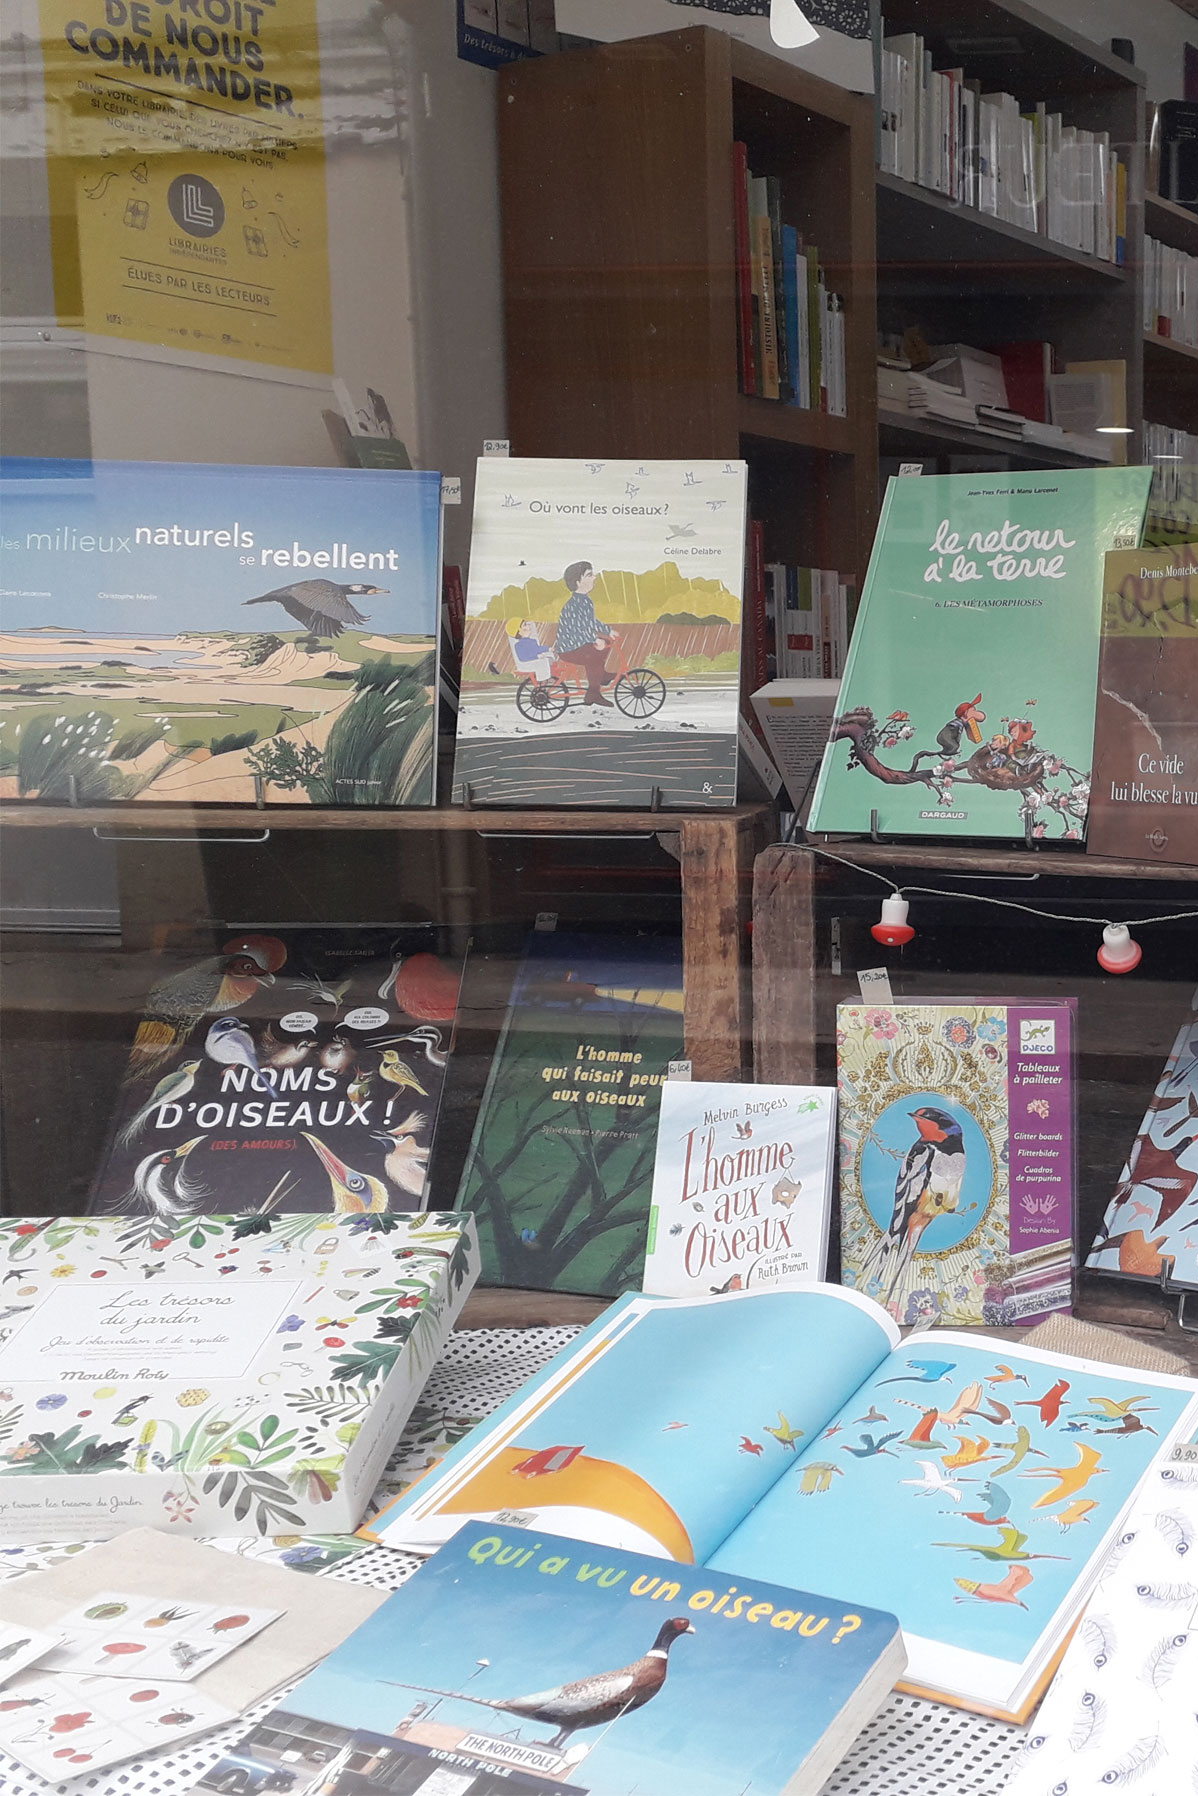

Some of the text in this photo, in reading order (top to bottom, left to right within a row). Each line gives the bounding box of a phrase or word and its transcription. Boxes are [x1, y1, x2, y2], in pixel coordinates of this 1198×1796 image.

[106, 0, 264, 72] DE NOUS
[64, 20, 304, 119] COMMANDER.
[168, 237, 227, 258] LIBRAIRIES
[128, 266, 270, 306] ÉLUES PAR LES LECTEURS
[529, 500, 608, 515] Où vont les
[25, 522, 255, 554] milieux naturels
[930, 518, 1076, 556] le retour
[239, 542, 399, 571] se rebellent
[663, 547, 722, 555] Céline Delabre
[923, 554, 1067, 582] à la terre
[1140, 566, 1163, 579] Denis
[962, 598, 1043, 608] MÉTAMORPHOSES
[1138, 753, 1184, 775] Ce vide
[1110, 781, 1128, 801] lui
[1130, 782, 1169, 804] blesse
[1171, 786, 1182, 804] la
[921, 811, 965, 819] DARGAUD
[576, 1045, 642, 1064] L'homme
[1022, 1044, 1054, 1053] DJECO
[542, 1066, 667, 1088] qui faisait peur
[1016, 1062, 1060, 1073] Tableaux
[220, 1067, 339, 1093] NOMS
[1022, 1074, 1063, 1086] pailleter
[552, 1088, 646, 1107] aux oiseaux
[155, 1101, 370, 1129] D'OISEAUX
[703, 1097, 788, 1127] Melvin Burgess
[211, 1138, 297, 1151] (DES AMOURS)
[1013, 1132, 1063, 1141] Glitter boards
[1017, 1149, 1060, 1157] Flitterbilder
[679, 1127, 795, 1202] L'homme
[1024, 1165, 1053, 1173] Cuadros
[1025, 1174, 1061, 1183] purpurina
[714, 1182, 766, 1225] aux
[1019, 1226, 1060, 1236] Sophie Abenia
[684, 1213, 794, 1279] Oiseaux
[757, 1261, 808, 1282] Ruth Brown
[160, 1292, 235, 1307] trésors
[100, 1307, 202, 1334] du jardin
[59, 1368, 169, 1380] Moulin Roty
[466, 1535, 832, 1639] Qui vu un oiseau
[464, 1735, 526, 1762] THE NORTH
[476, 1761, 512, 1777] POLE
